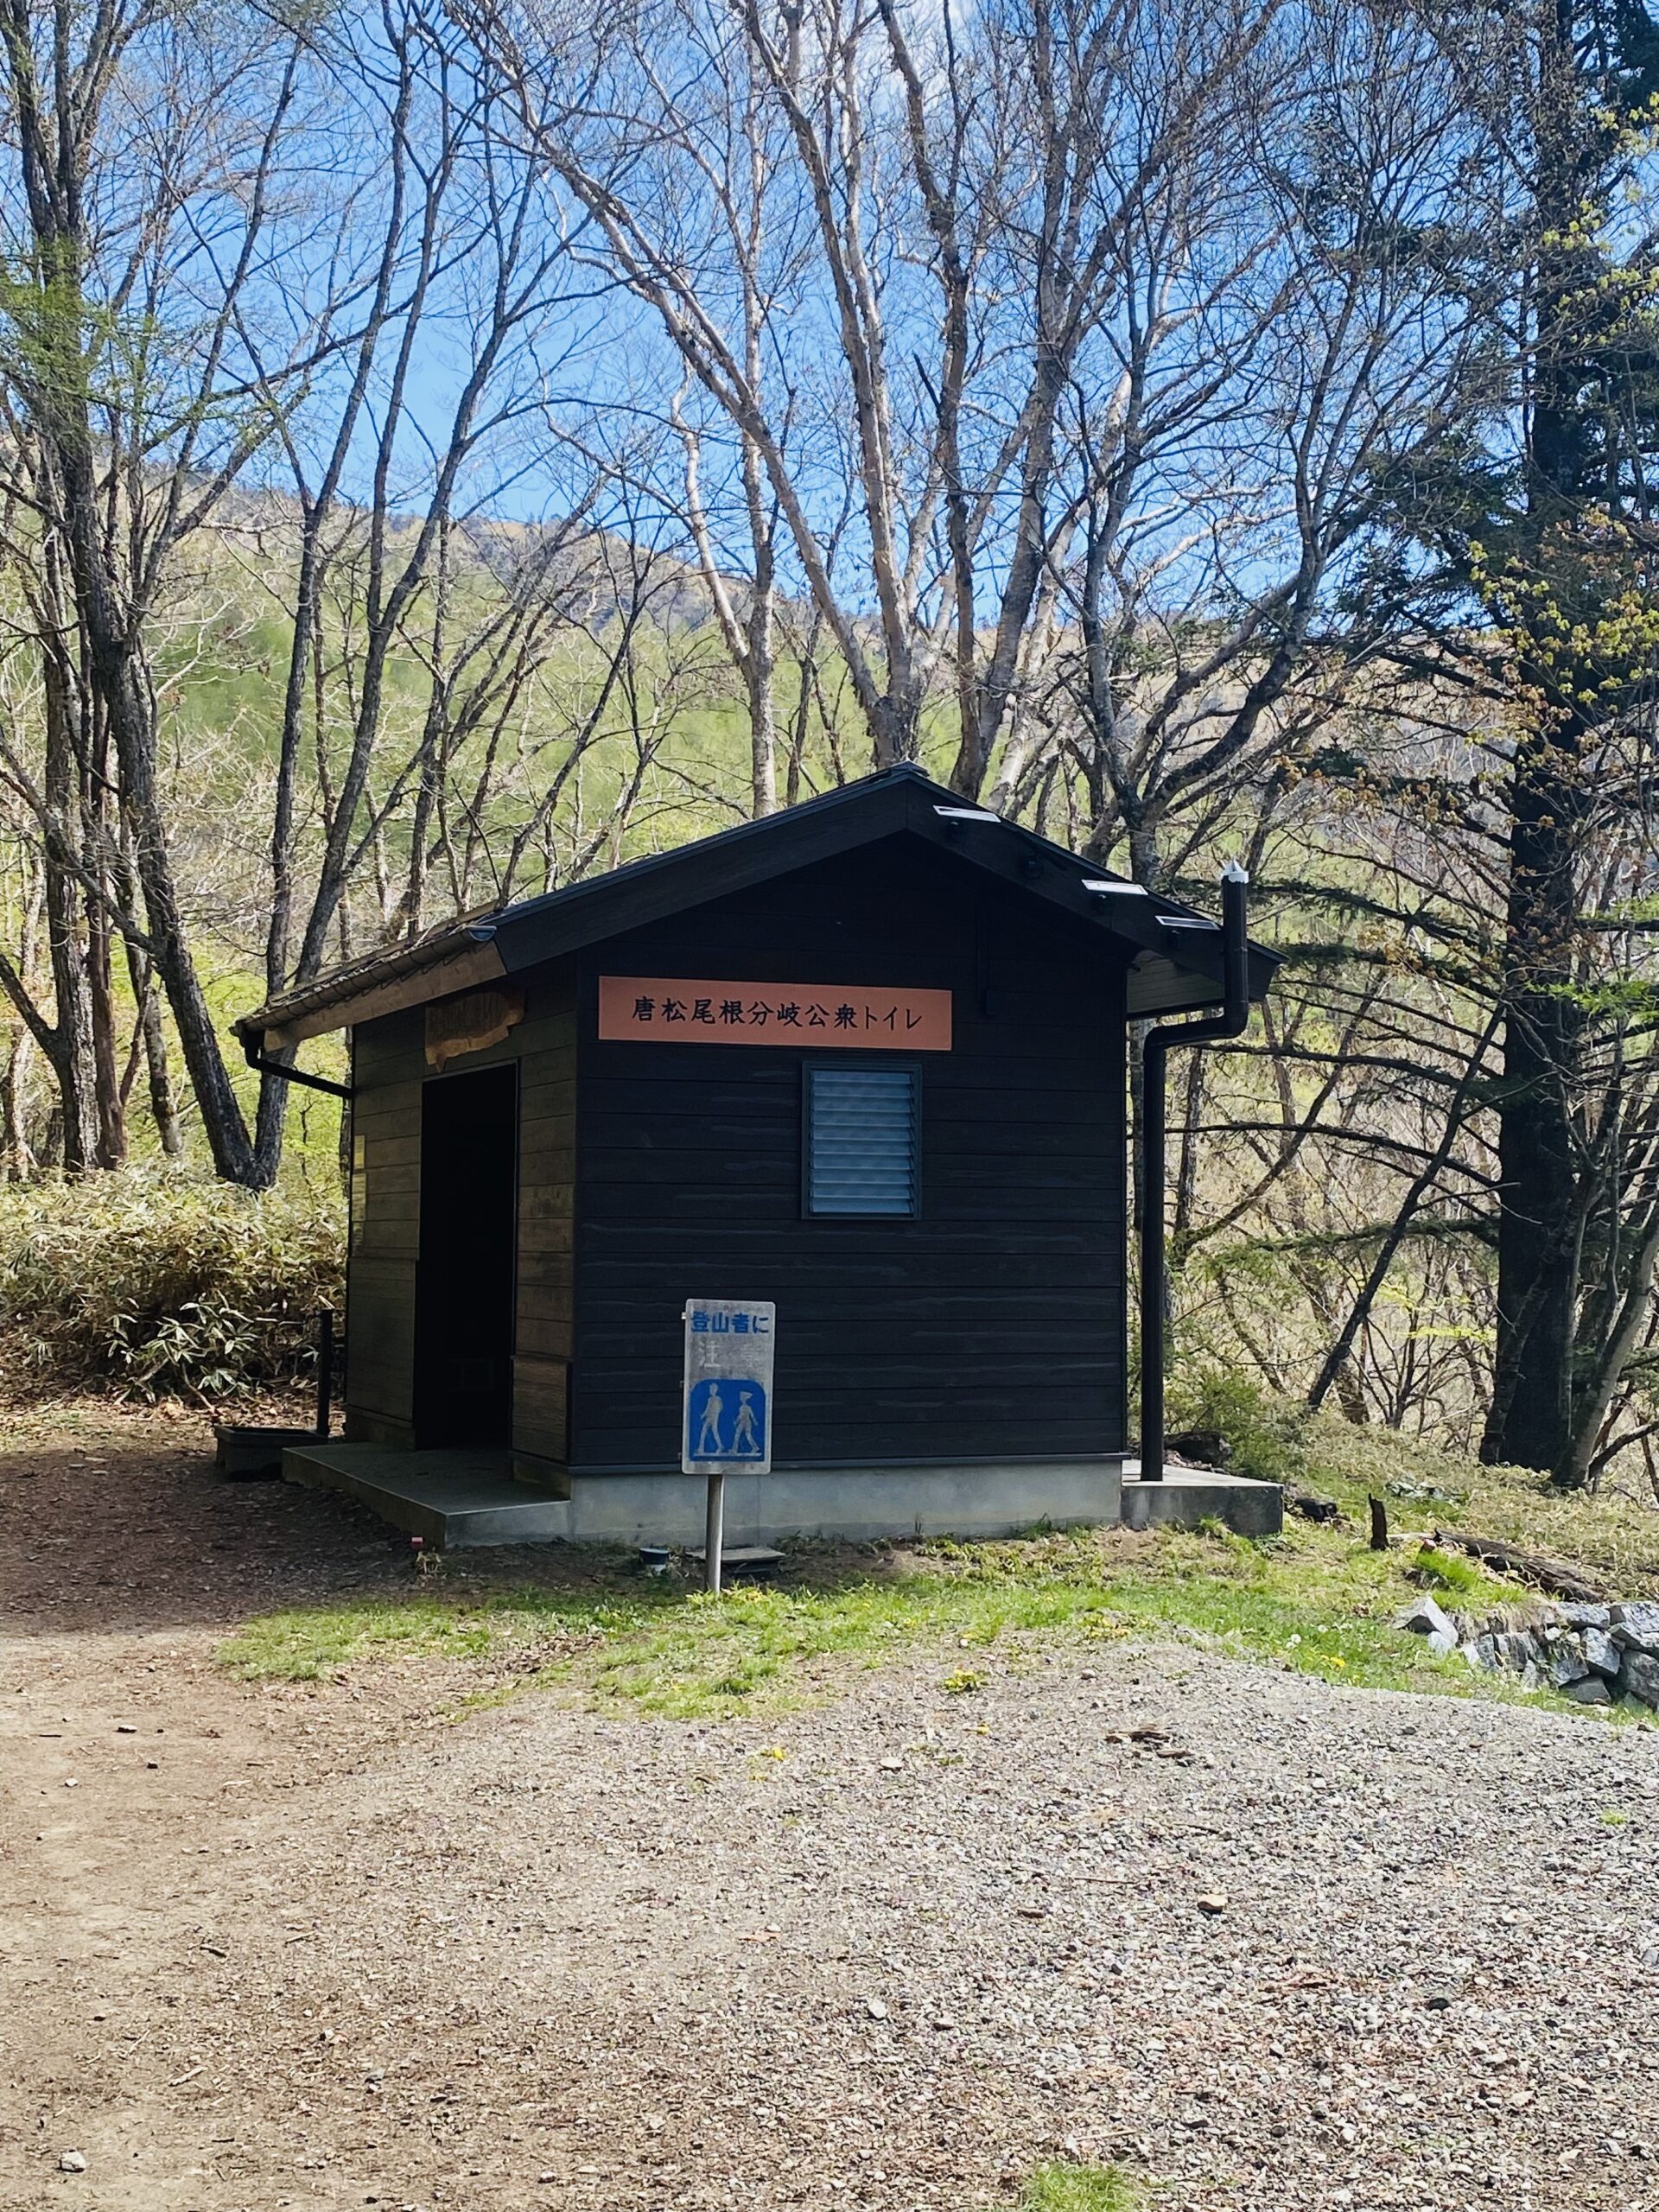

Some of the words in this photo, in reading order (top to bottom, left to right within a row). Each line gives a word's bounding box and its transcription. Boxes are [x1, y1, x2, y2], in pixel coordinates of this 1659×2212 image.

[632, 995, 923, 1031] 唐松尾根分岐公衆トイレ
[691, 1311, 769, 1334] 登山者に
